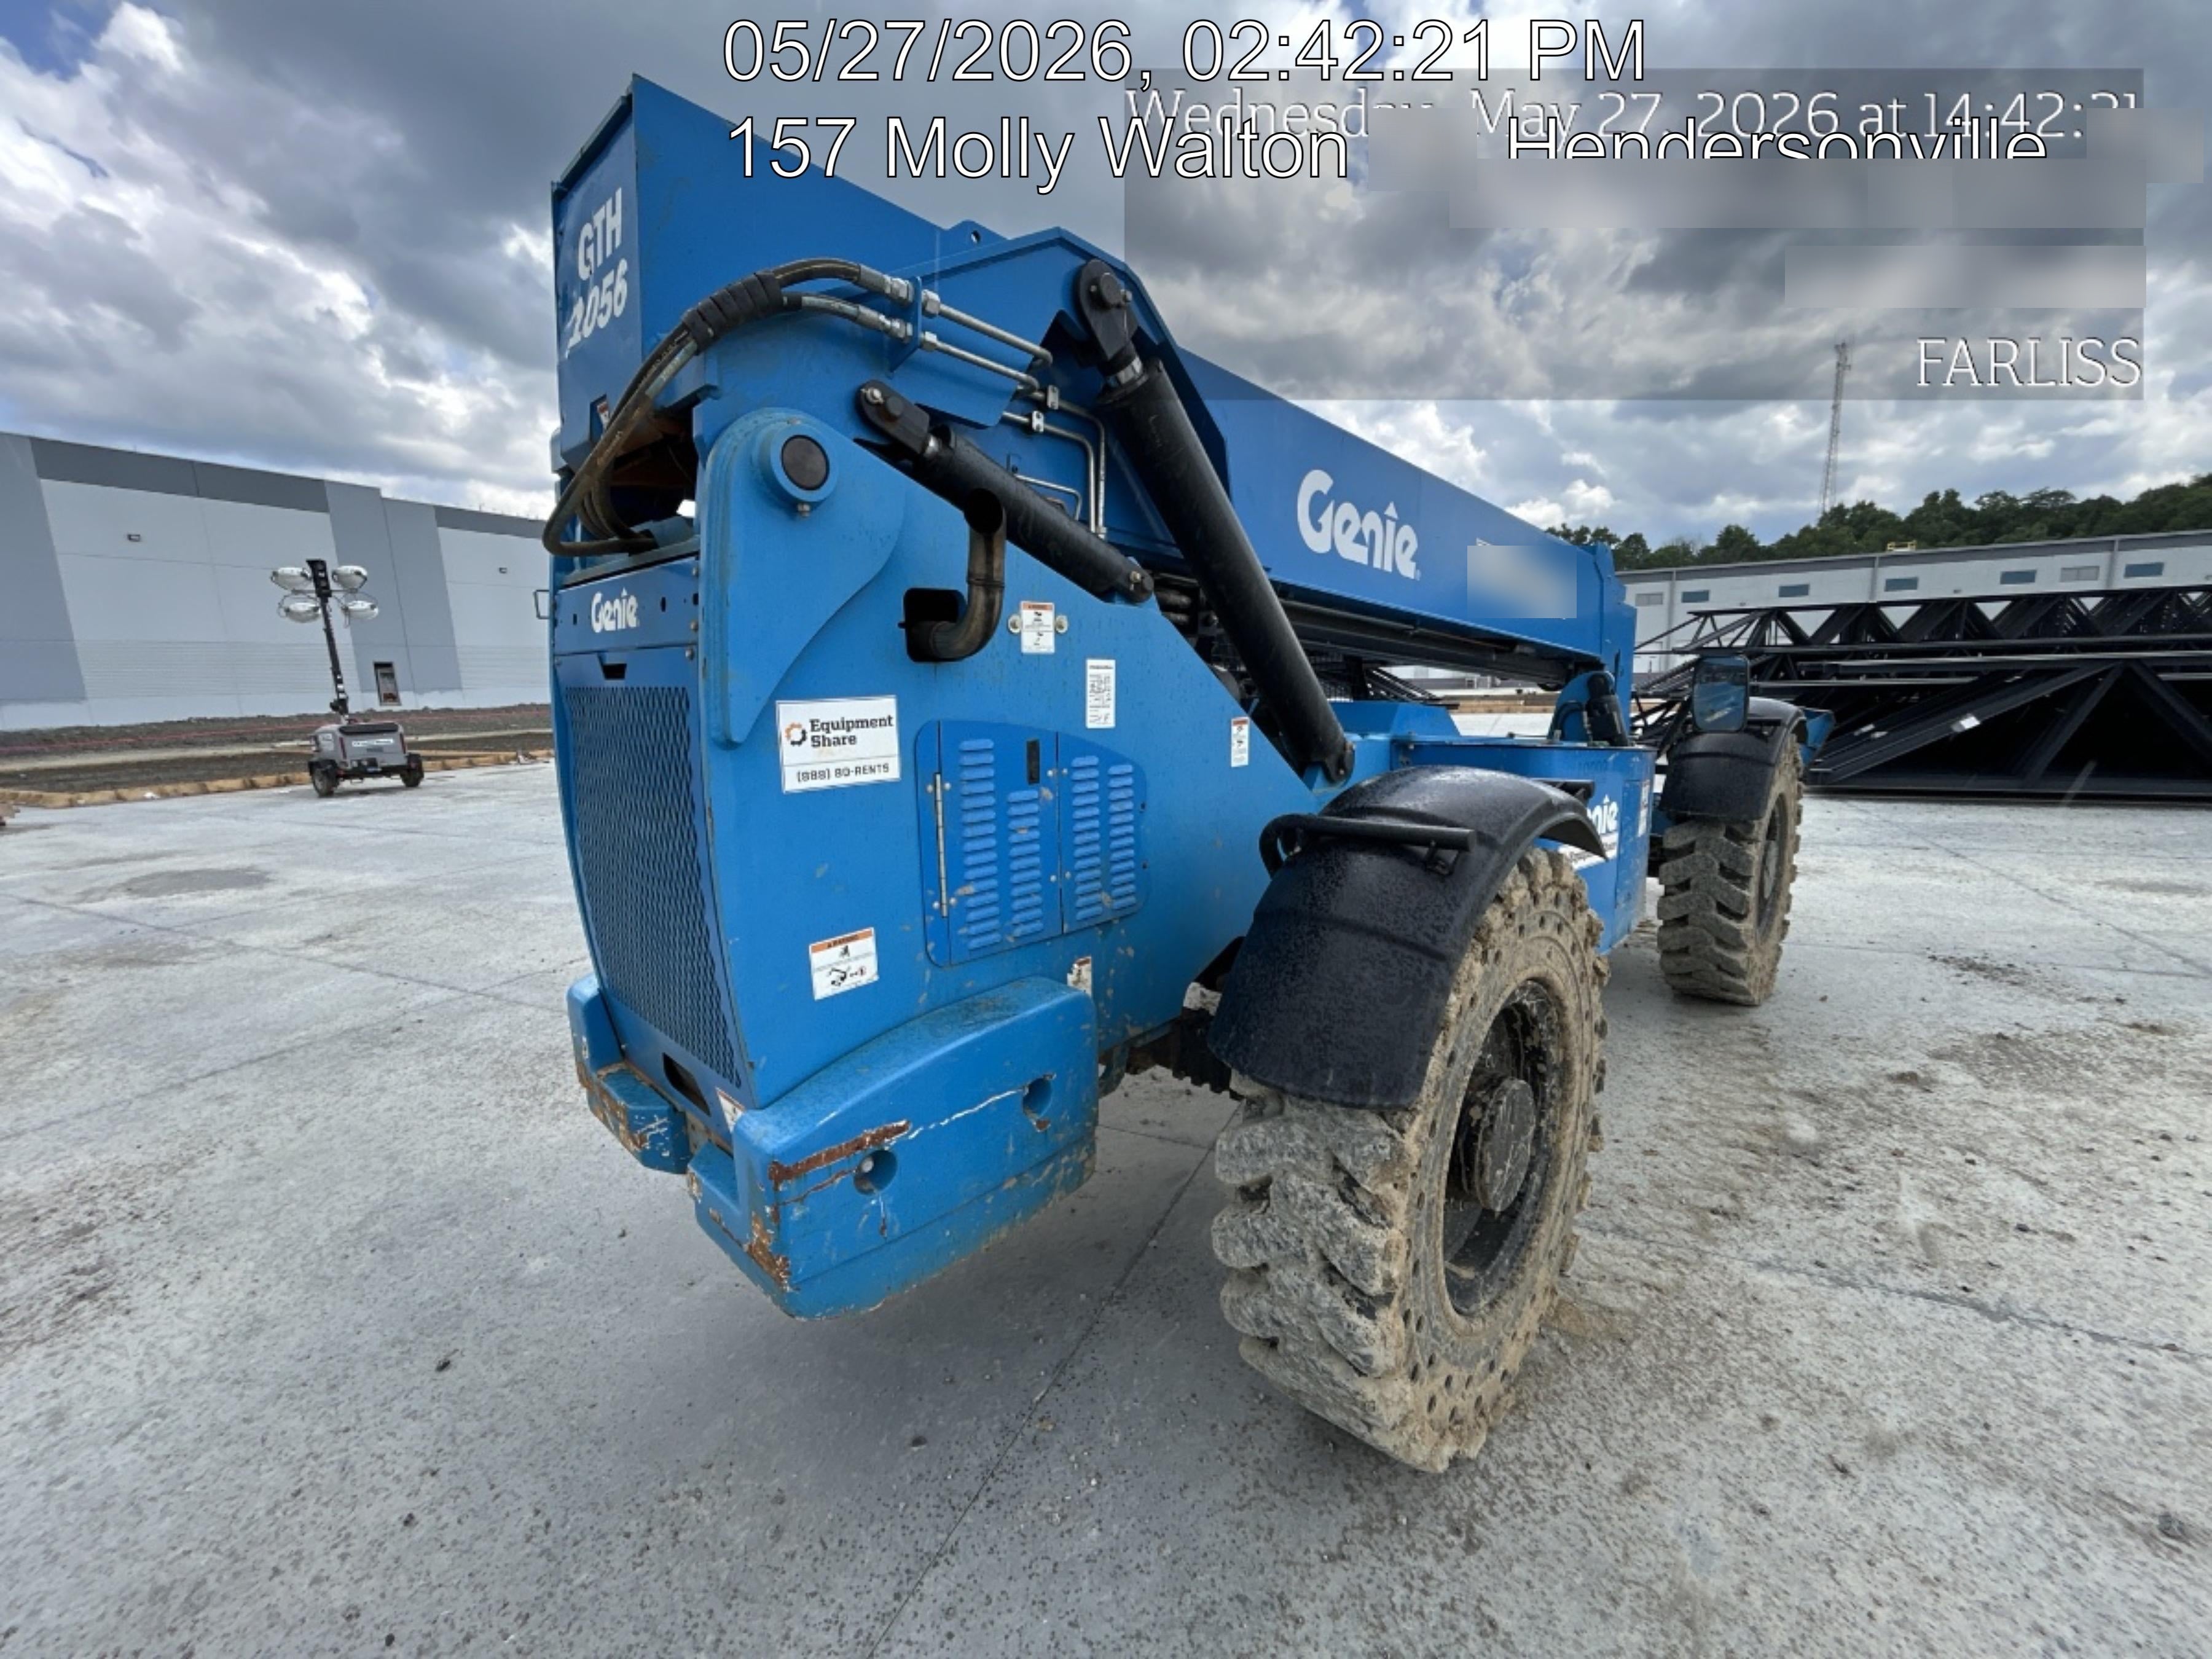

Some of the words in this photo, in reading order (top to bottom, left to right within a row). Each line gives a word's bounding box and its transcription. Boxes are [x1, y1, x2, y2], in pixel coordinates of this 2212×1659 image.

[578, 186, 622, 281] GTH
[565, 258, 627, 350] 1056
[1297, 469, 1419, 580] Genie
[591, 587, 638, 633] Genie
[809, 714, 894, 734] Equipment
[810, 734, 858, 748] Share
[1586, 794, 1618, 835] nie
